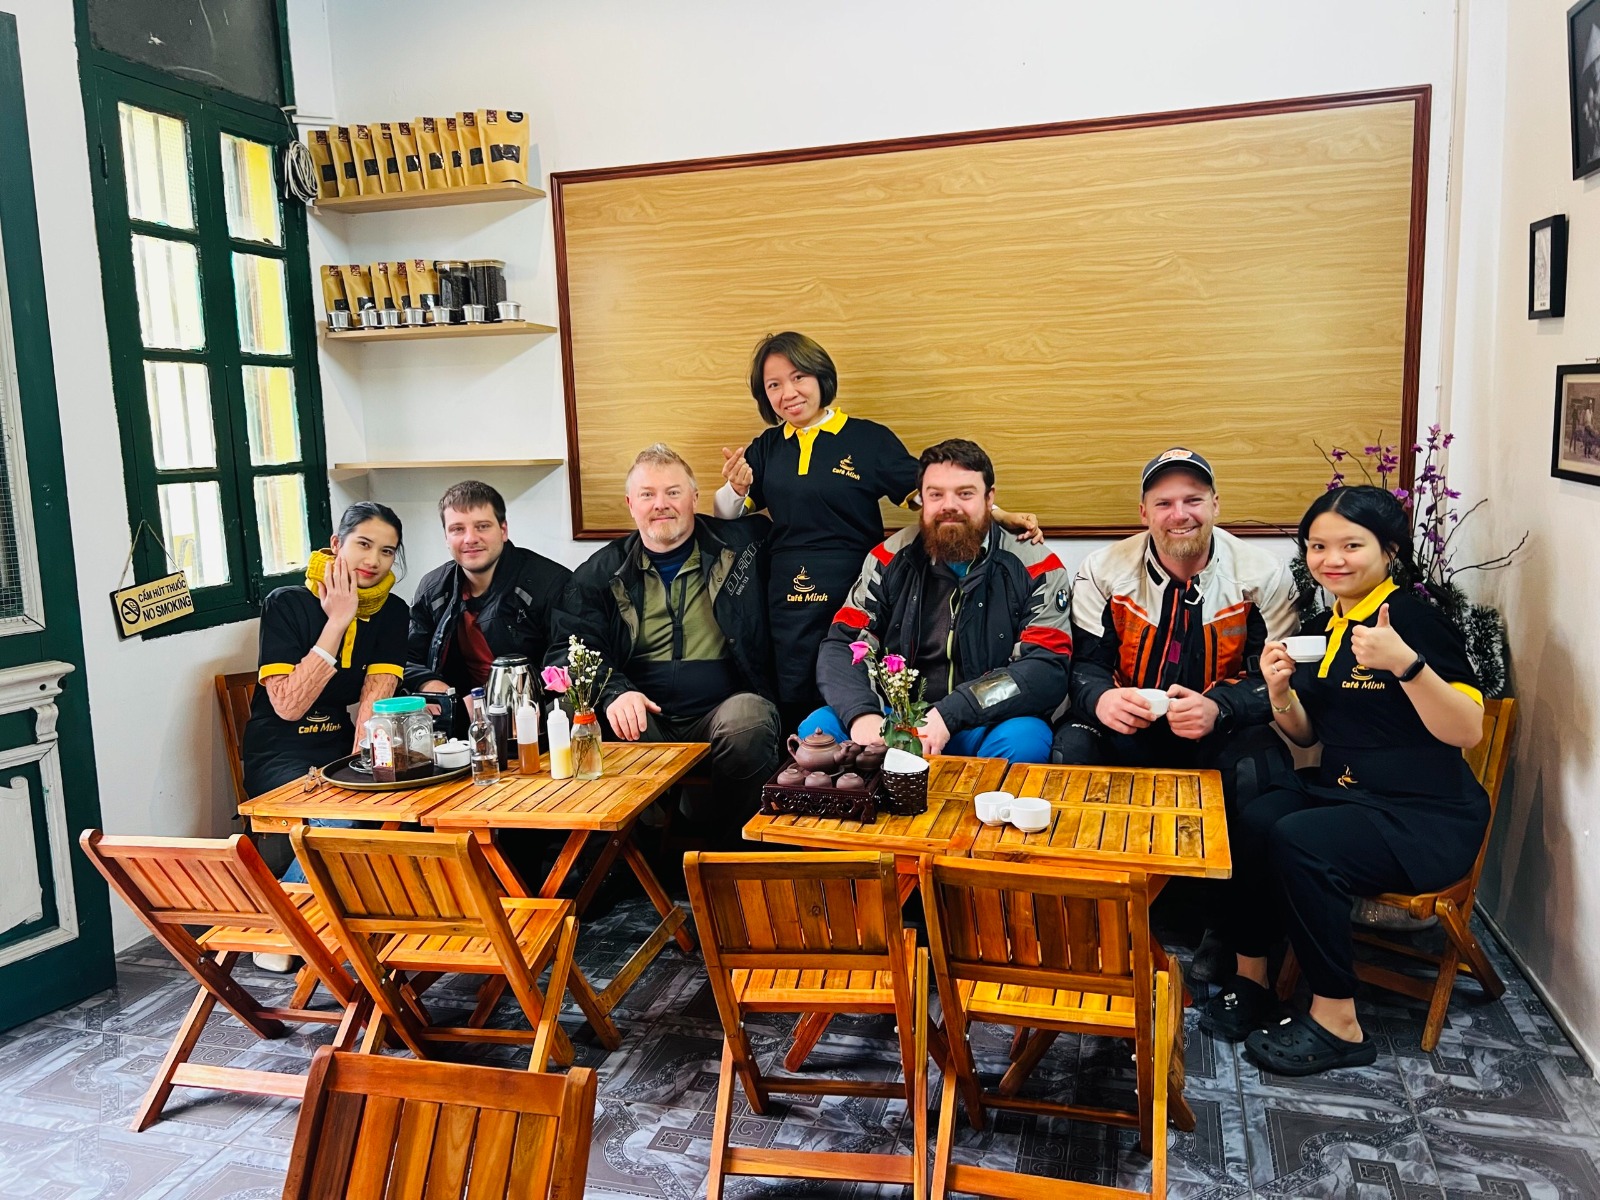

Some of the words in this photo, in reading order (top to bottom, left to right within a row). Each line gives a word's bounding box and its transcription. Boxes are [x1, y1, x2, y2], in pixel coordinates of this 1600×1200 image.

[153, 585, 165, 599] HÚT
[786, 593, 803, 602] Café
[804, 592, 828, 602] Minh
[142, 607, 156, 622] NO
[156, 595, 192, 618] SMOKING
[1341, 680, 1360, 689] Café
[1361, 681, 1386, 690] Minh
[298, 724, 319, 734] Café
